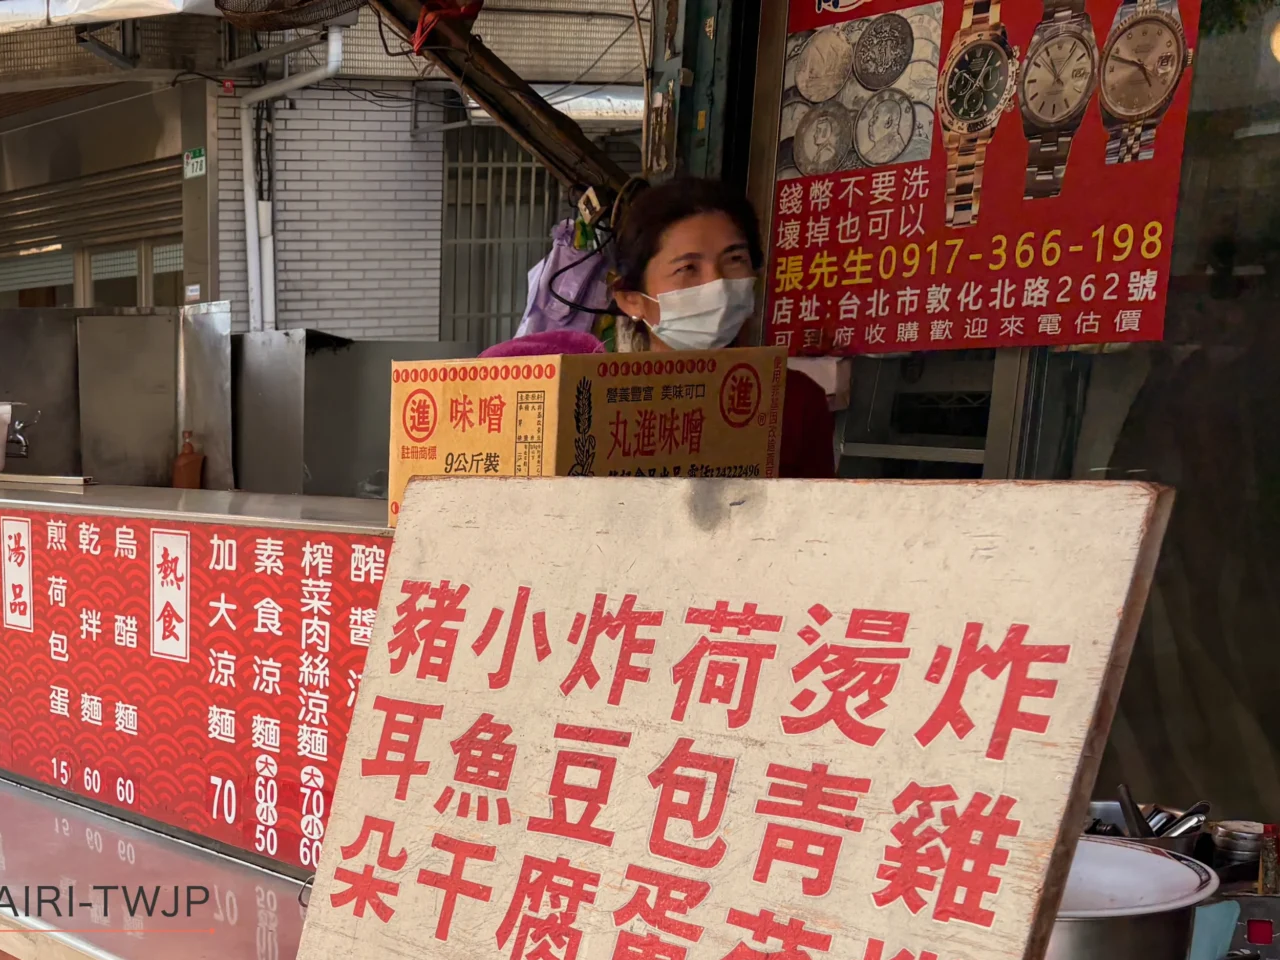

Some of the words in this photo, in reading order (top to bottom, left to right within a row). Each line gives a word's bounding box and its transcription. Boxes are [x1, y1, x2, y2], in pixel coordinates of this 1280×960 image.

[778, 165, 930, 215] 錢幣不要洗
[774, 220, 1163, 293] 張先生0917-366-198
[776, 203, 925, 250] 壞掉也可以
[771, 268, 1158, 325] 店址:台北市敦化北路262號
[409, 398, 431, 433] 進
[449, 394, 506, 434] 味噌
[661, 383, 706, 401] 美味可口
[727, 374, 753, 416] 進
[444, 452, 500, 474] 9公斤裝
[606, 406, 707, 460] 丸進味噌
[7, 532, 28, 617] 湯品
[156, 547, 185, 642] 熱食
[46, 519, 70, 718] 煎荷包蛋
[78, 522, 102, 726] 乾拌麵
[114, 525, 138, 736] 烏醋麵
[208, 533, 237, 743] 加大涼麵
[251, 537, 284, 753] 素食涼麵
[297, 540, 333, 761] 榨菜肉絲涼麵
[330, 577, 471, 924] 豬耳朵
[415, 584, 552, 941] 小魚干
[51, 757, 68, 785] 15
[84, 767, 101, 794] 60
[116, 777, 135, 805] 60
[210, 775, 237, 825] 70
[299, 787, 325, 818] 70
[255, 824, 278, 856] 50
